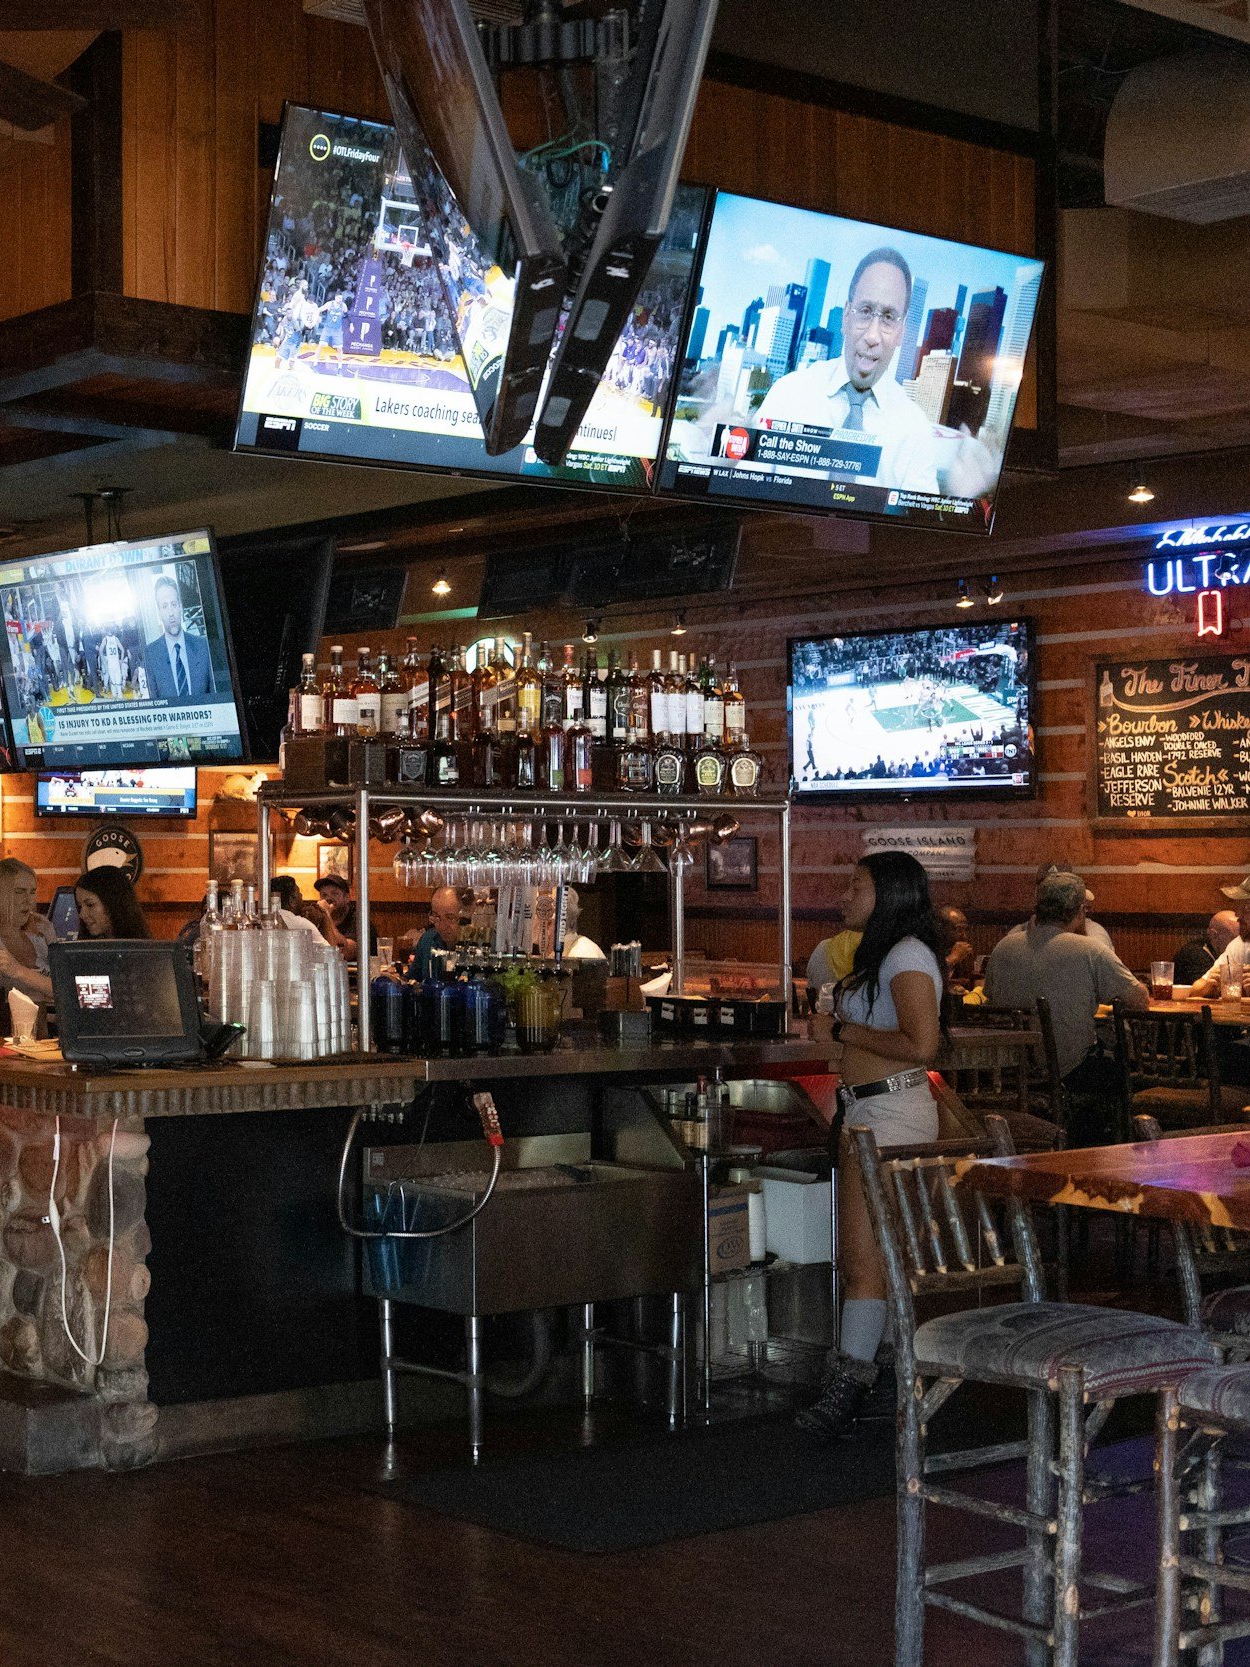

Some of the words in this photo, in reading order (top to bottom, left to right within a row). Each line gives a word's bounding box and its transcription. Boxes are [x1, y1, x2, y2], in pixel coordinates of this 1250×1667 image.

[333, 145, 380, 163] #OTLFridayFour
[314, 392, 330, 408] BIG
[330, 395, 359, 410] STORY
[310, 406, 320, 415] OF
[321, 408, 335, 416] THE
[336, 409, 355, 419] WEEK
[375, 397, 409, 416] Lakers
[412, 405, 458, 426] coaching
[462, 409, 480, 424] sea
[264, 416, 297, 431] ESPN
[303, 422, 330, 432] SOCCER
[759, 434, 778, 448] Call
[779, 437, 794, 450] the
[795, 440, 821, 454] Show
[758, 449, 809, 464] 1-888-SAY-ESPN
[732, 471, 749, 480] Johns
[749, 473, 765, 482] Hopk
[773, 476, 793, 485] Florida
[110, 550, 144, 568] DOWN
[1121, 666, 1164, 697] The
[1169, 662, 1229, 693] Finer
[58, 720, 65, 729] IS
[66, 719, 89, 729] INJURY
[91, 718, 100, 727] TO
[101, 717, 111, 726] KD
[118, 714, 152, 725] BLESSING
[153, 713, 168, 723] FOR
[169, 710, 212, 722] WARRIORS?
[1106, 713, 1178, 735] Bourbon
[1202, 709, 1250, 730] Whiske
[1135, 735, 1156, 748] ENVY
[1163, 741, 1192, 751] DOUBLE
[1194, 741, 1217, 750] OAKED
[1131, 750, 1162, 763] HAYDEN
[1189, 748, 1222, 759] RESERVE
[1136, 764, 1160, 777] RARE
[1162, 760, 1220, 787] Scotch
[1110, 793, 1155, 807] RESERVE
[1212, 797, 1248, 810] WALKER
[95, 832, 131, 848] GOOSE
[869, 836, 914, 847] GOOSE
[916, 836, 966, 847] ISLAND
